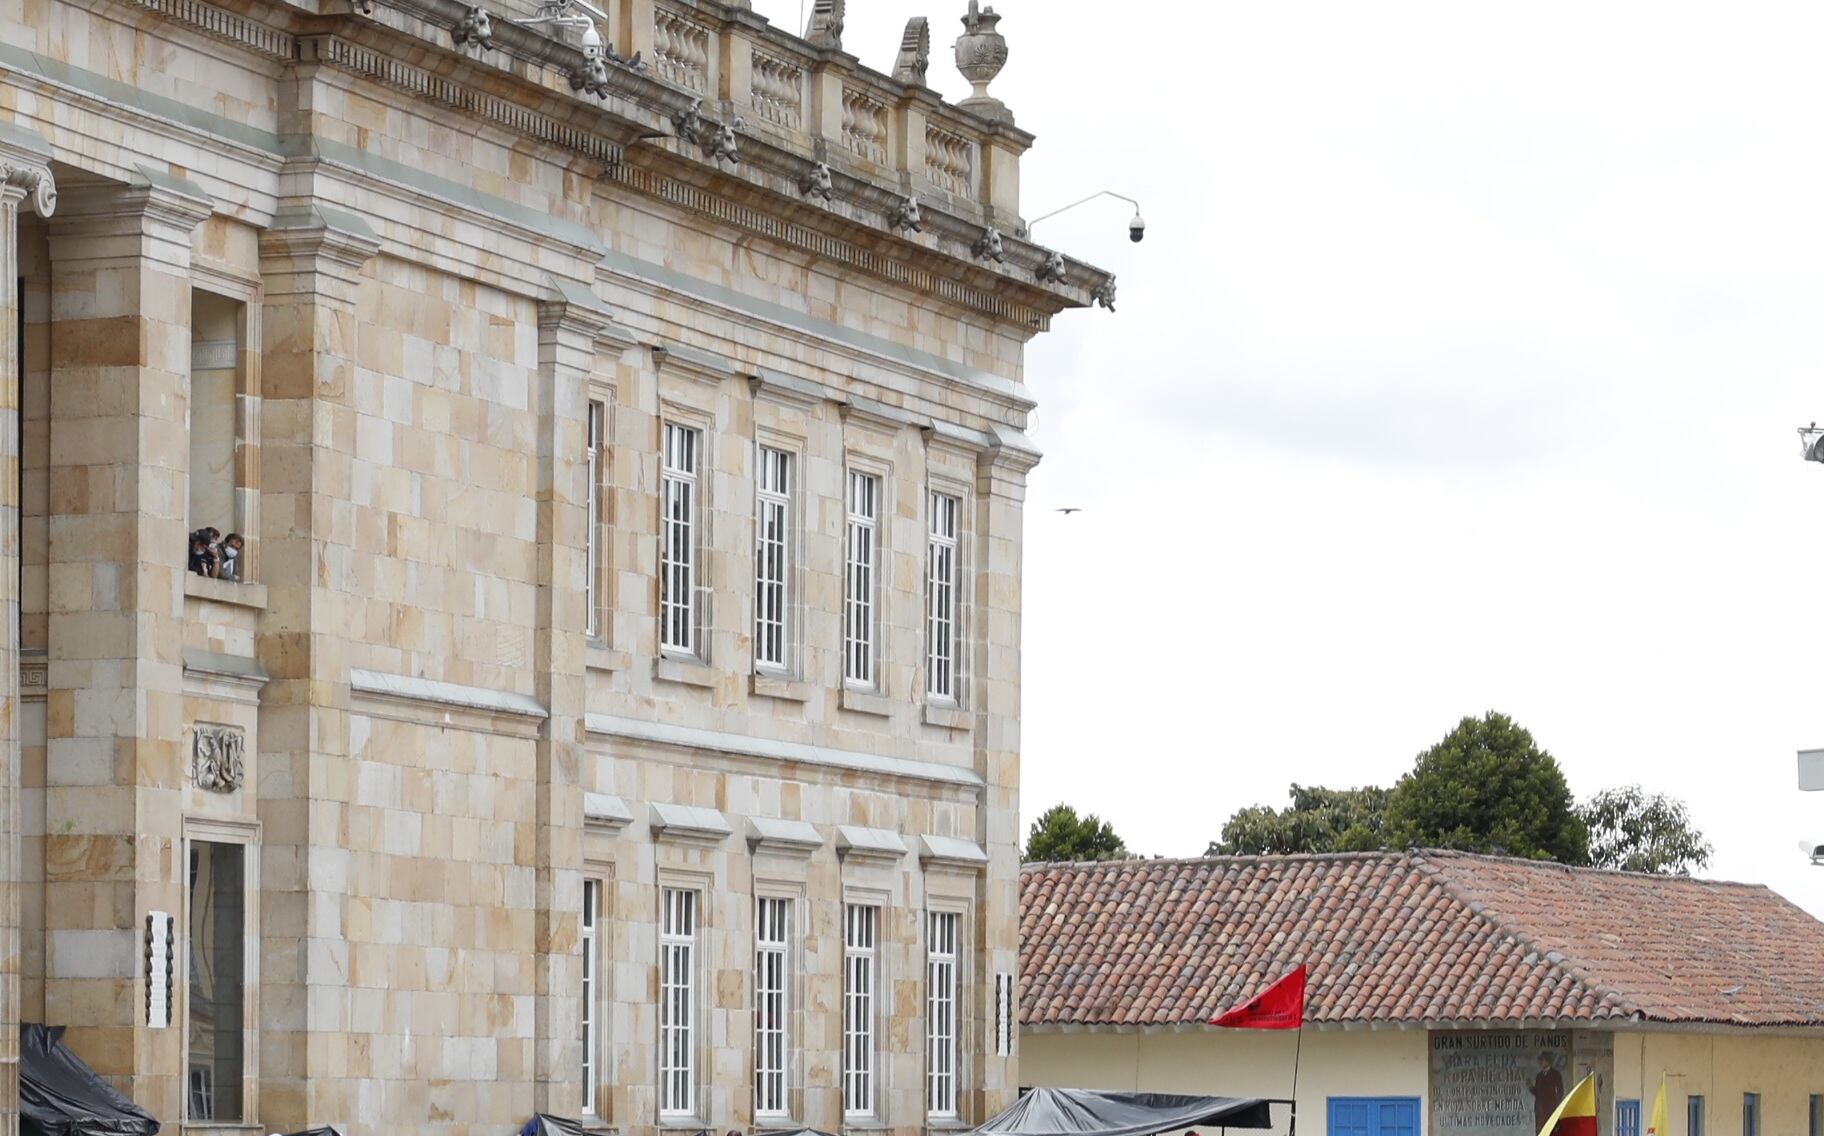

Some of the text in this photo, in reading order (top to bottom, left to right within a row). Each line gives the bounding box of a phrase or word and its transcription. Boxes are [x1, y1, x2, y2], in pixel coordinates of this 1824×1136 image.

[1434, 1035, 1463, 1050] GRAN
[1466, 1034, 1511, 1049] SURTIDO
[1515, 1034, 1529, 1048] DE
